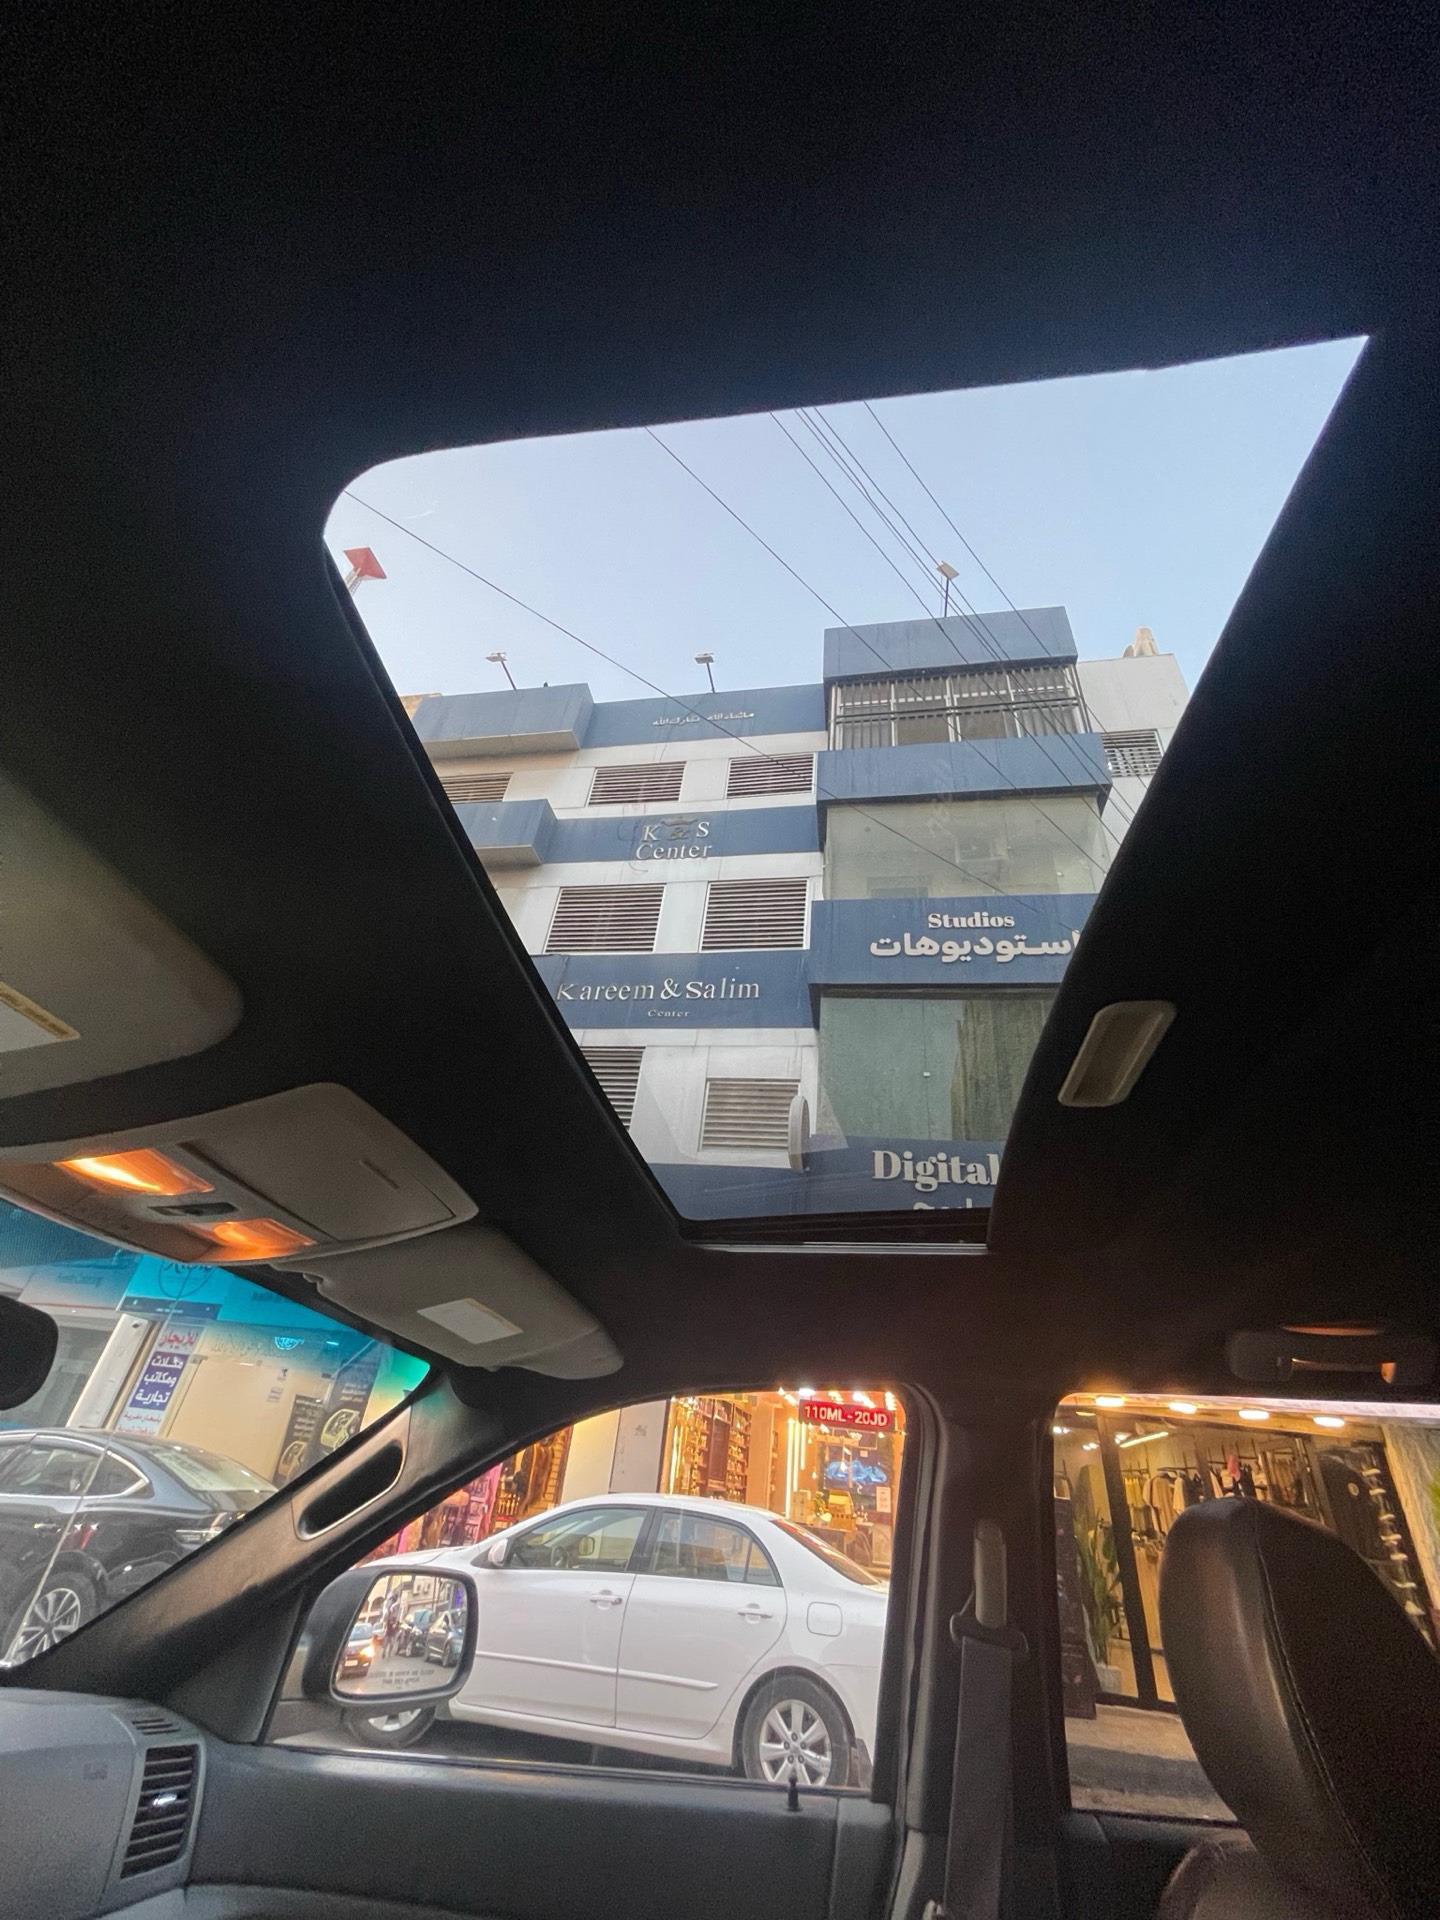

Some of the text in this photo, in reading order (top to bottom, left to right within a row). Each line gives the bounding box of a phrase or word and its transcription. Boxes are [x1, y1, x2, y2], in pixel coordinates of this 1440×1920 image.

[641, 825, 661, 842] K
[696, 821, 711, 838] S
[636, 843, 713, 860] Center
[927, 911, 1016, 929] Studios
[556, 977, 760, 1000] Kareem & Salim
[647, 1009, 691, 1018] Center
[872, 1150, 1000, 1193] Digital
[143, 1371, 177, 1388] ومكاتب
[135, 1389, 171, 1406] تجارية
